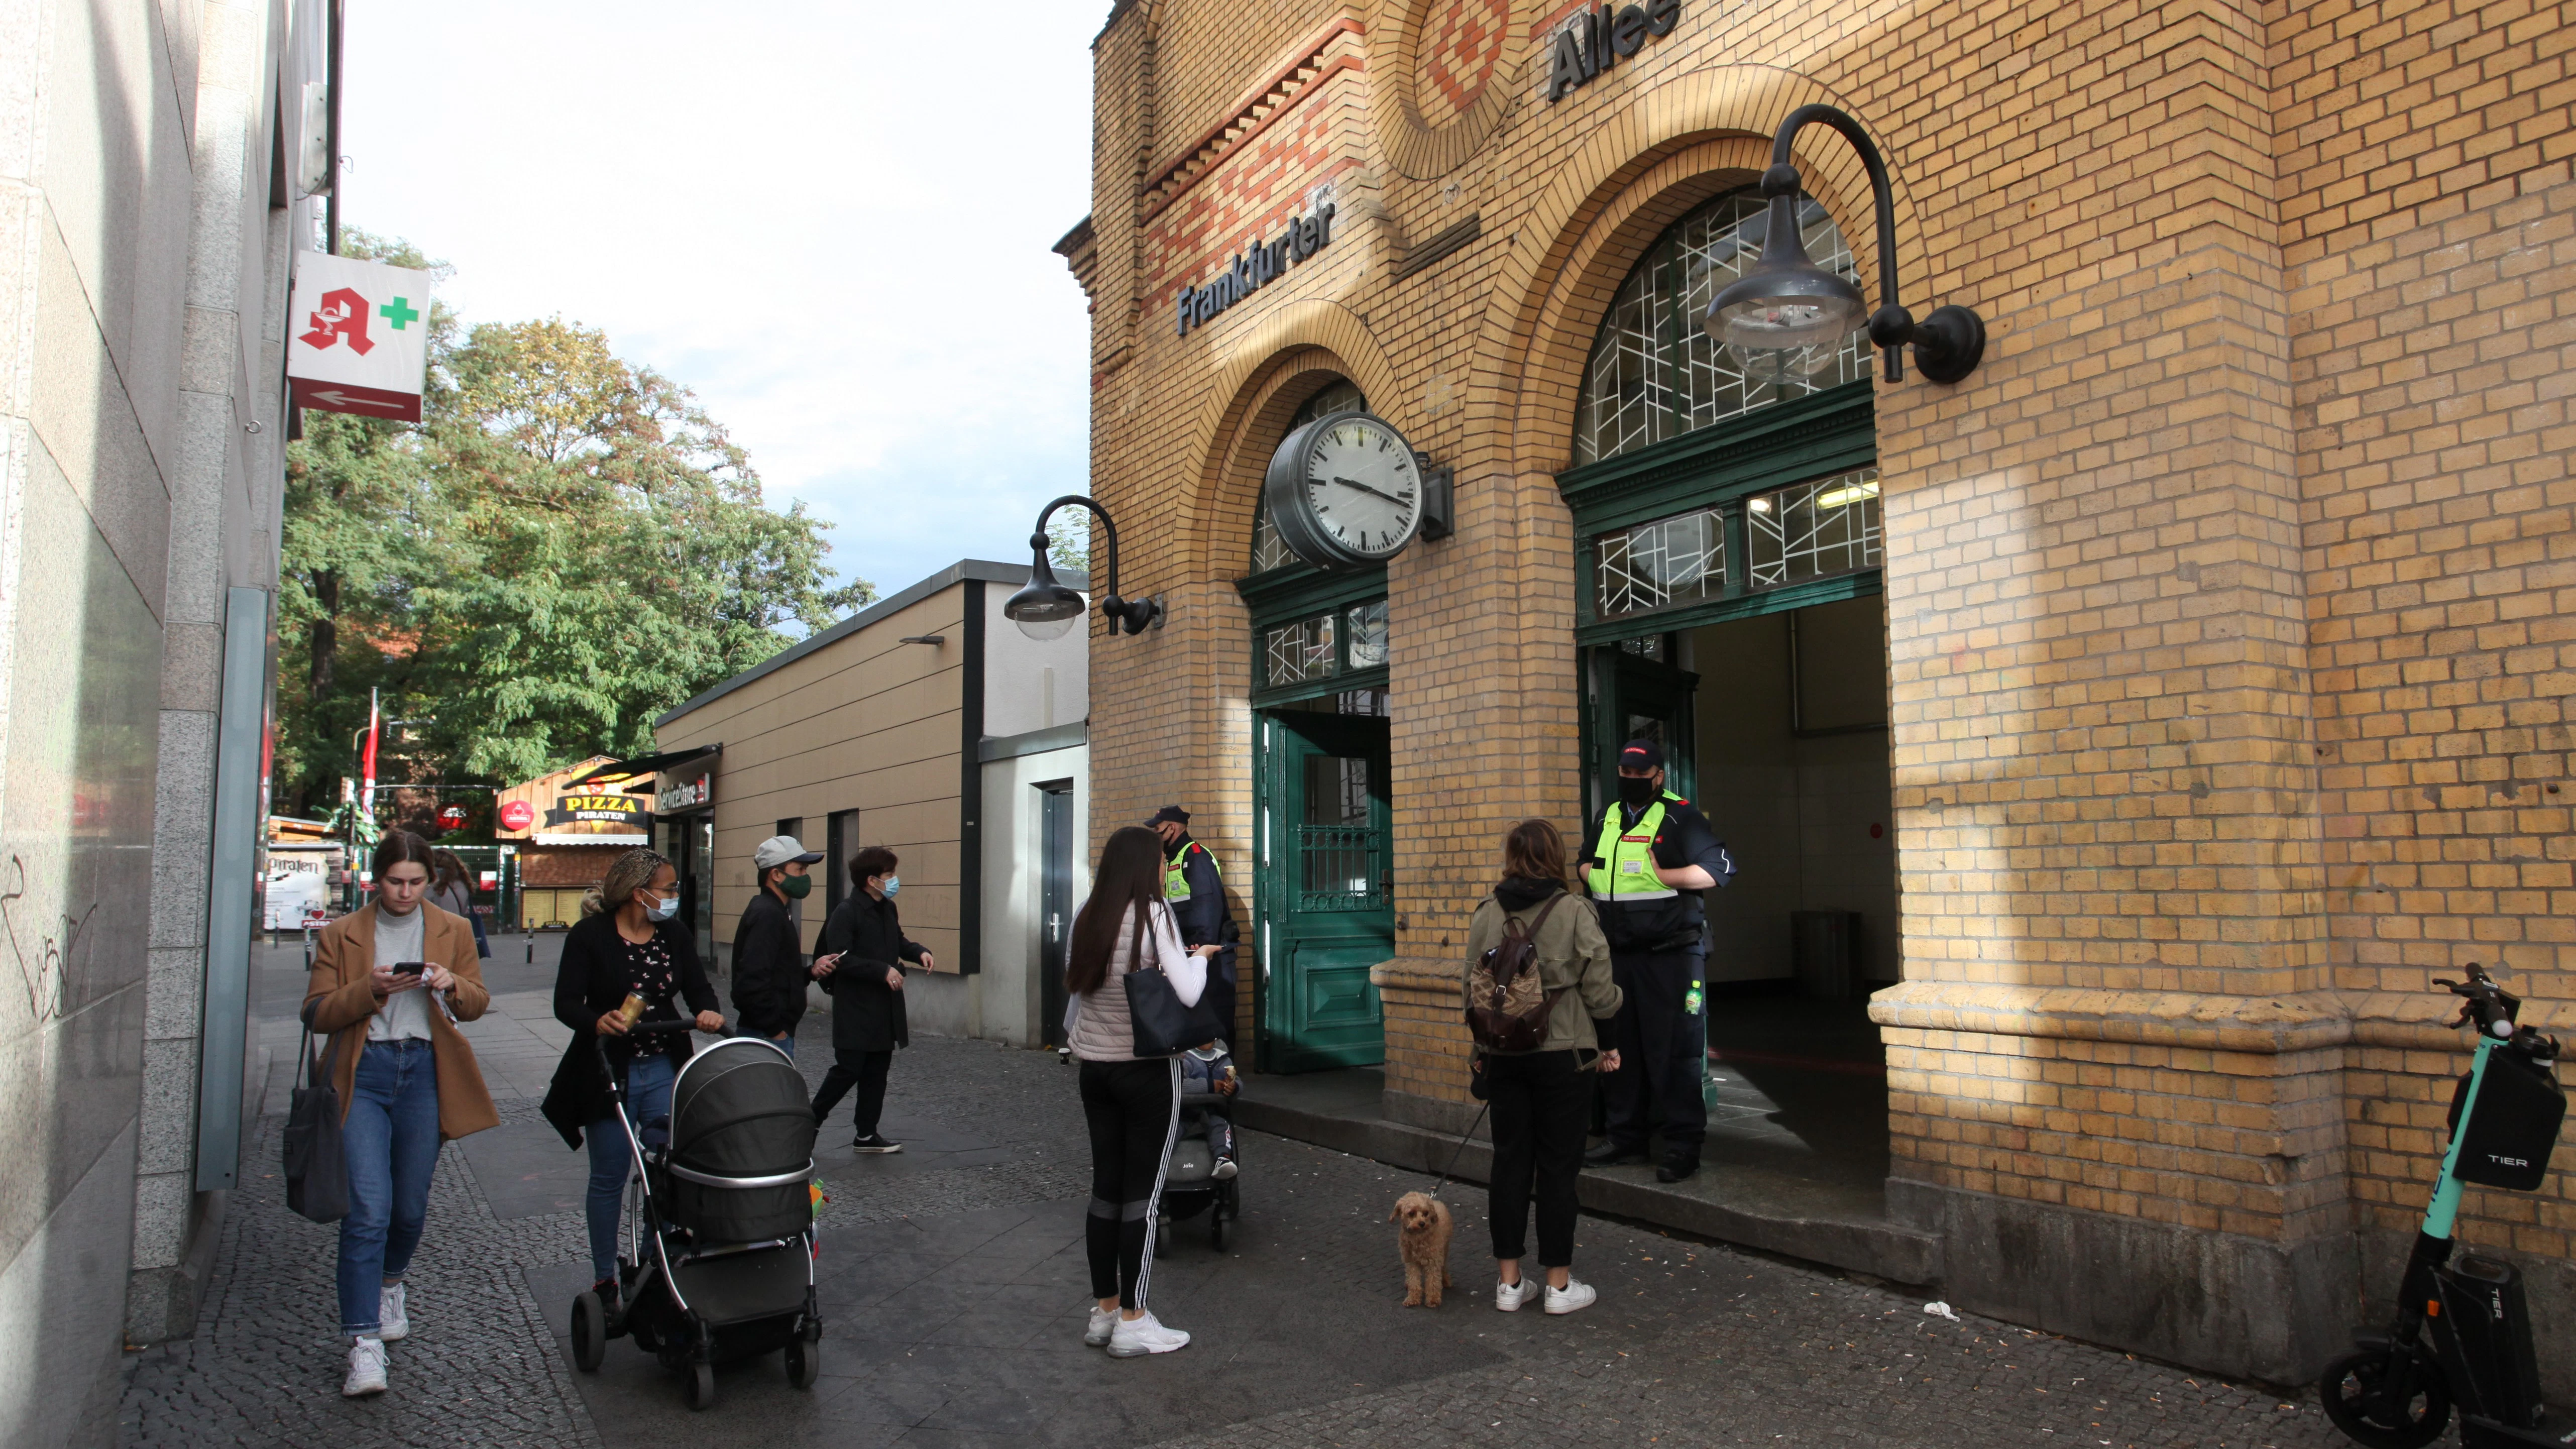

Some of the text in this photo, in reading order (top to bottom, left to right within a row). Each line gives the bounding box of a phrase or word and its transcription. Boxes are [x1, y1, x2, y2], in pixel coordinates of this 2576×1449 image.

[1548, 0, 1682, 103] Allee
[1177, 203, 1335, 336] Frankfurter
[565, 797, 637, 813] PIZZA
[659, 782, 696, 811] ServiceStore
[576, 811, 626, 820] PIRATEN
[2488, 1154, 2528, 1167] TIER
[2491, 1287, 2502, 1318] TIER
